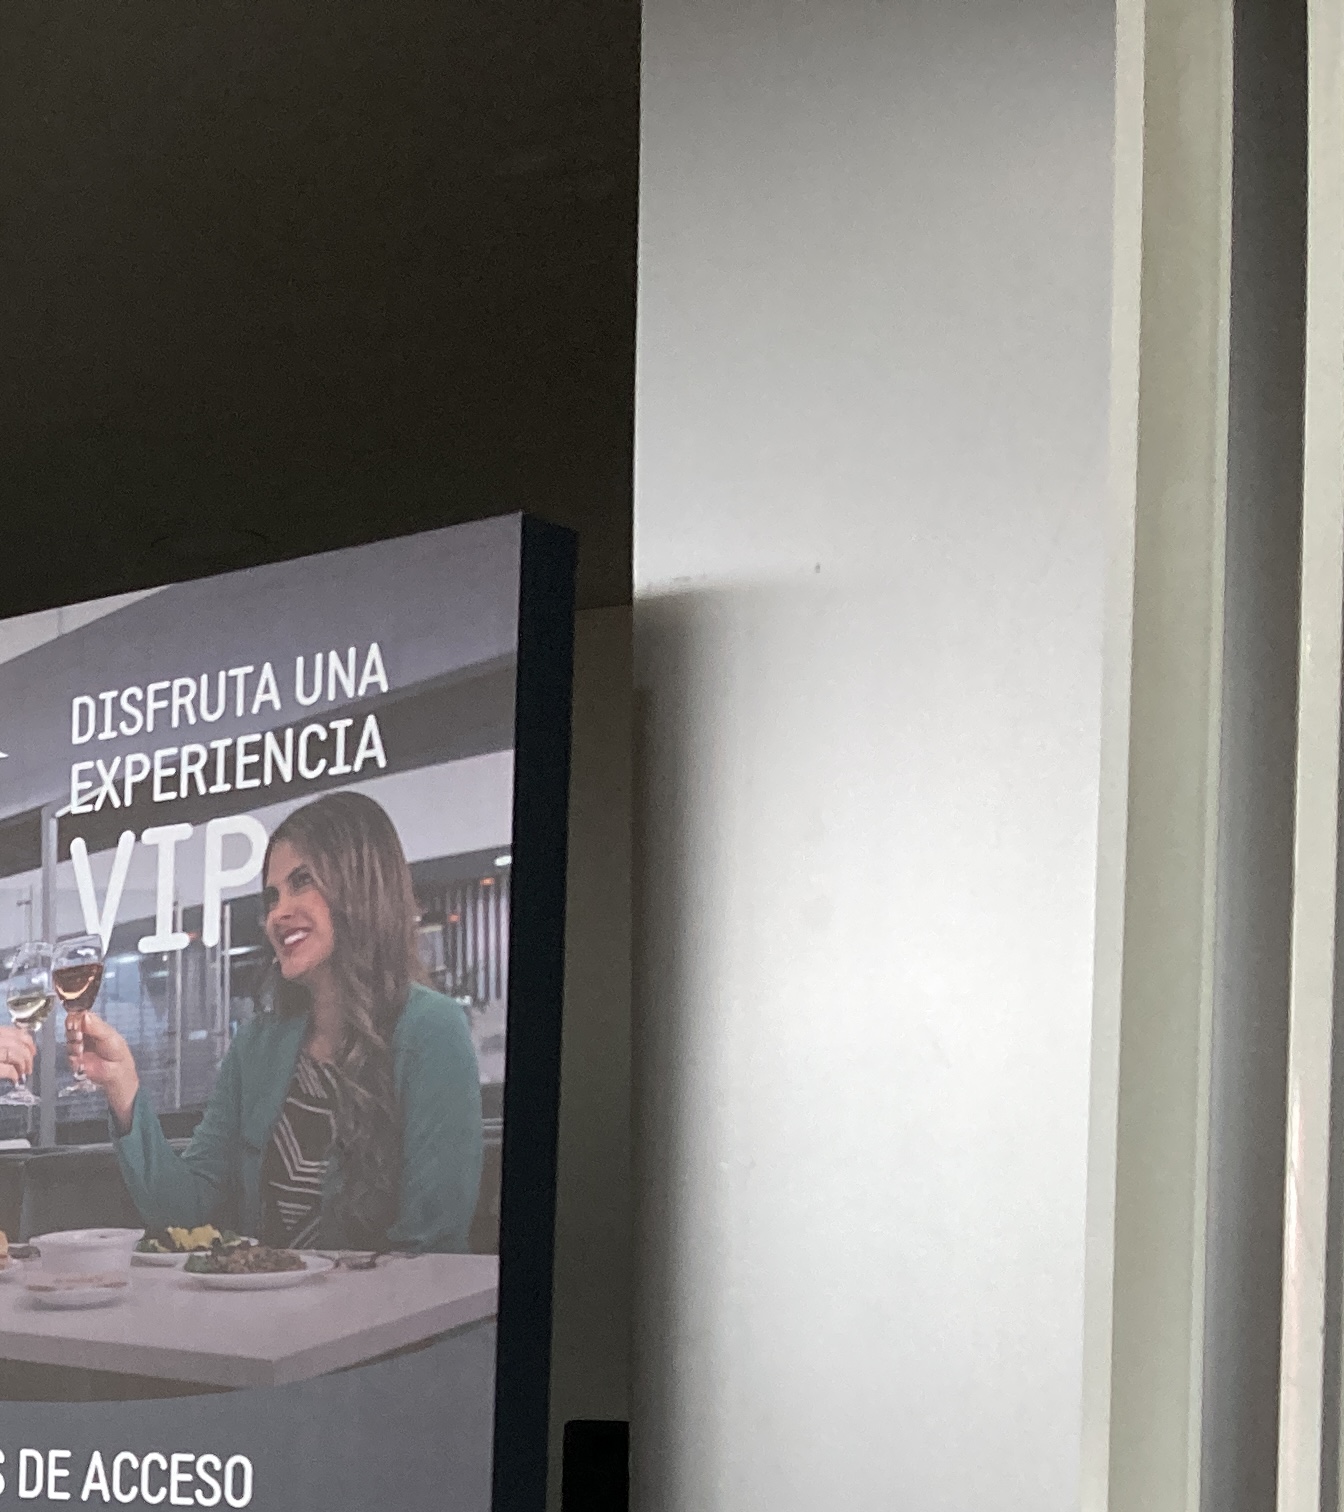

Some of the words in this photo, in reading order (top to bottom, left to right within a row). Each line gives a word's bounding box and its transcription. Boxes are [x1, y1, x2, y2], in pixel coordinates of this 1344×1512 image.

[72, 661, 283, 747] DISFRUTA
[295, 642, 389, 703] UNA
[70, 714, 387, 816] EXPERIENCIA
[70, 815, 268, 955] VIP
[18, 1448, 72, 1501] DE
[81, 1450, 254, 1508] ACCESO
